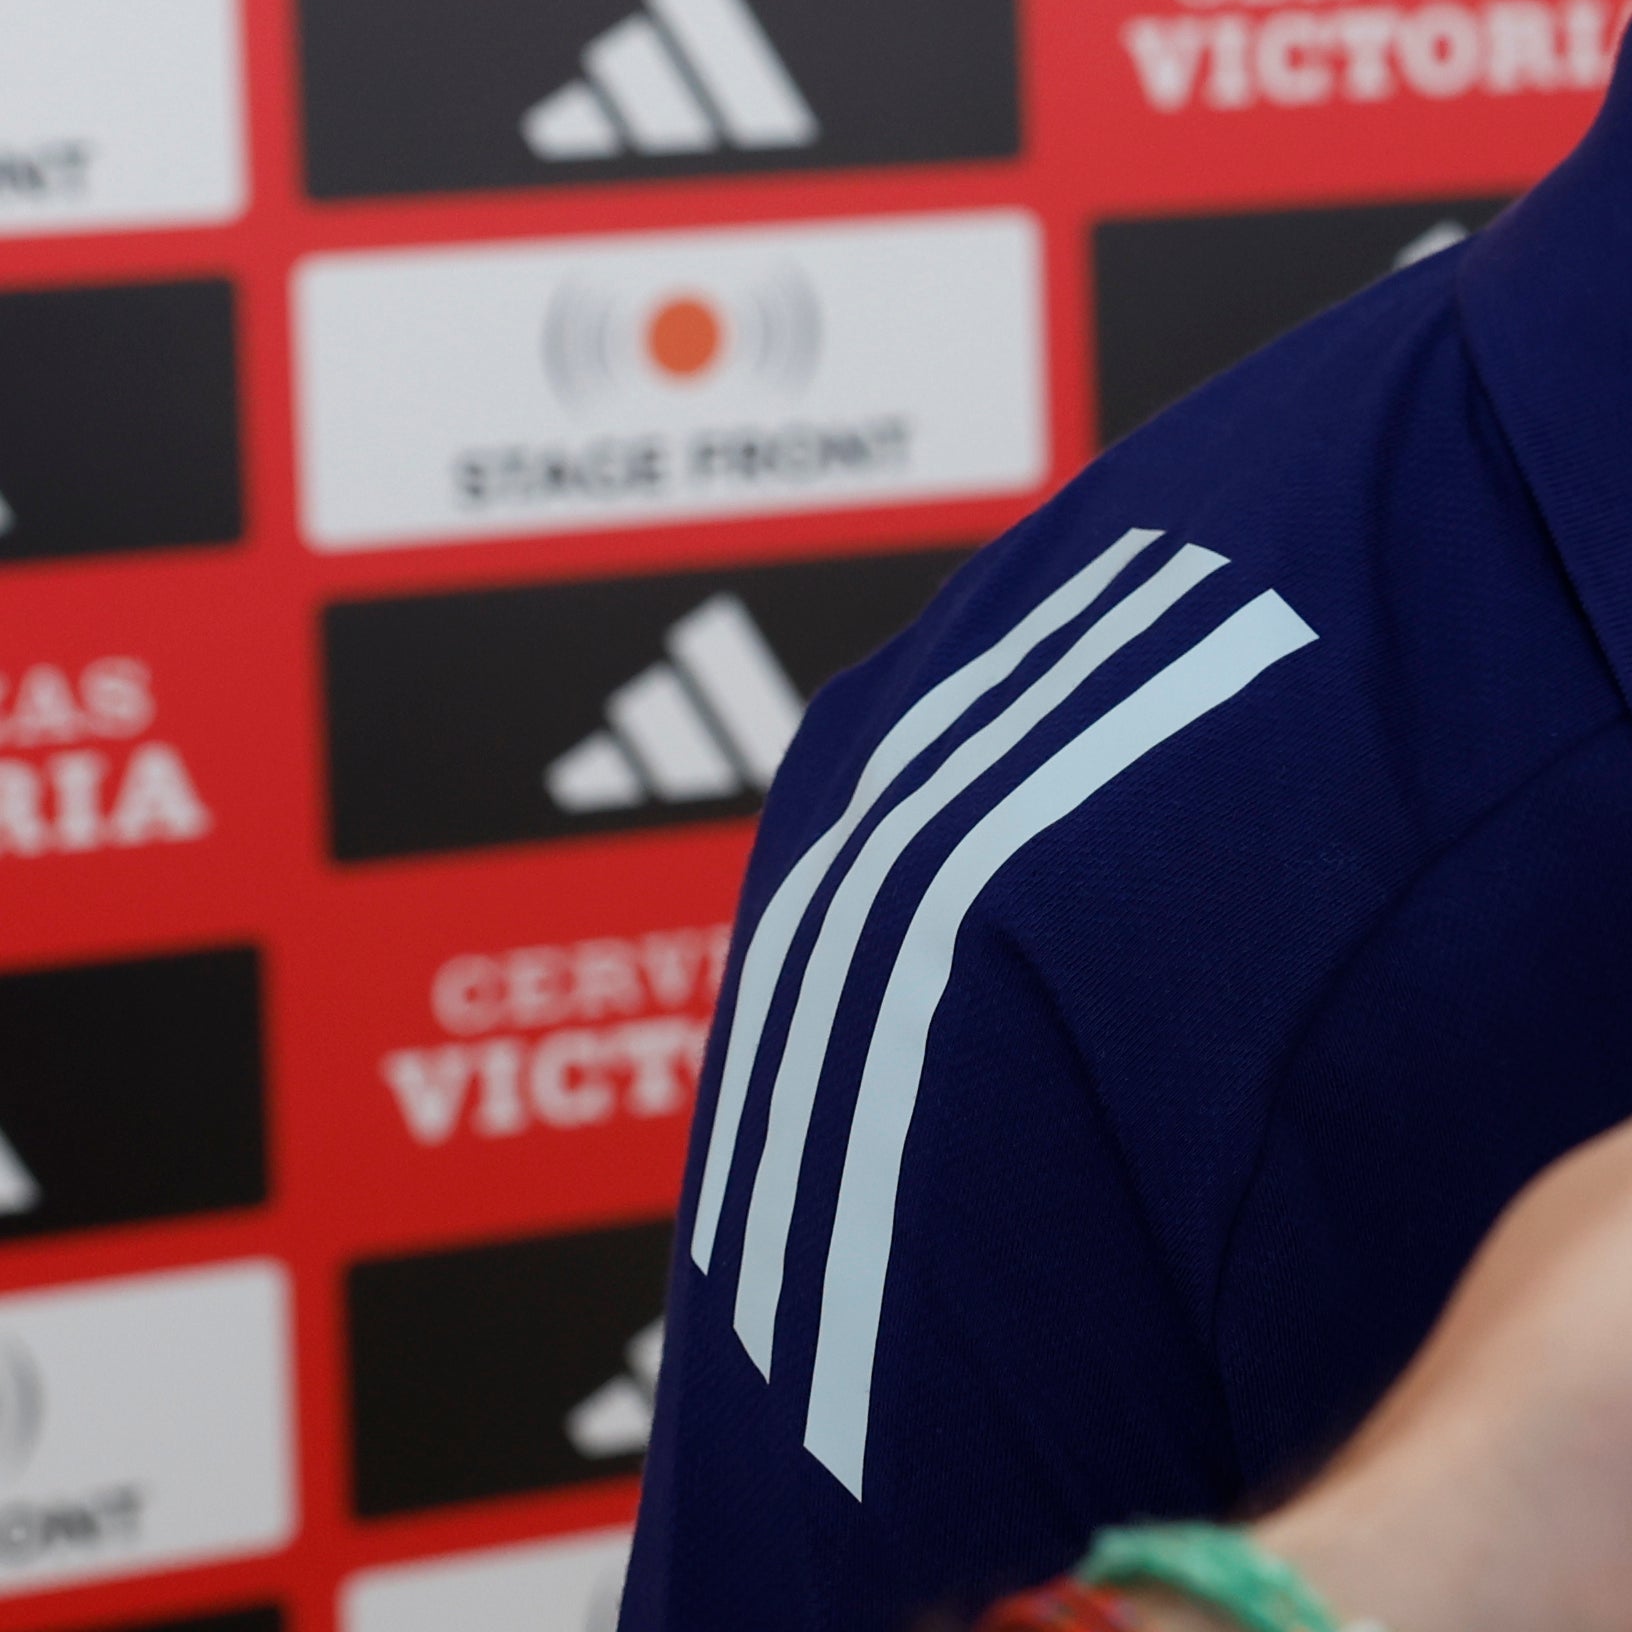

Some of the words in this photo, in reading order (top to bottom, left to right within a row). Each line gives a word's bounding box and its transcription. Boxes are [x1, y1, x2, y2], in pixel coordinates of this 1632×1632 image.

[453, 436, 670, 511] STAGE
[687, 417, 910, 484] FRONT
[433, 925, 731, 1032] CERV
[384, 1017, 709, 1144] VICT
